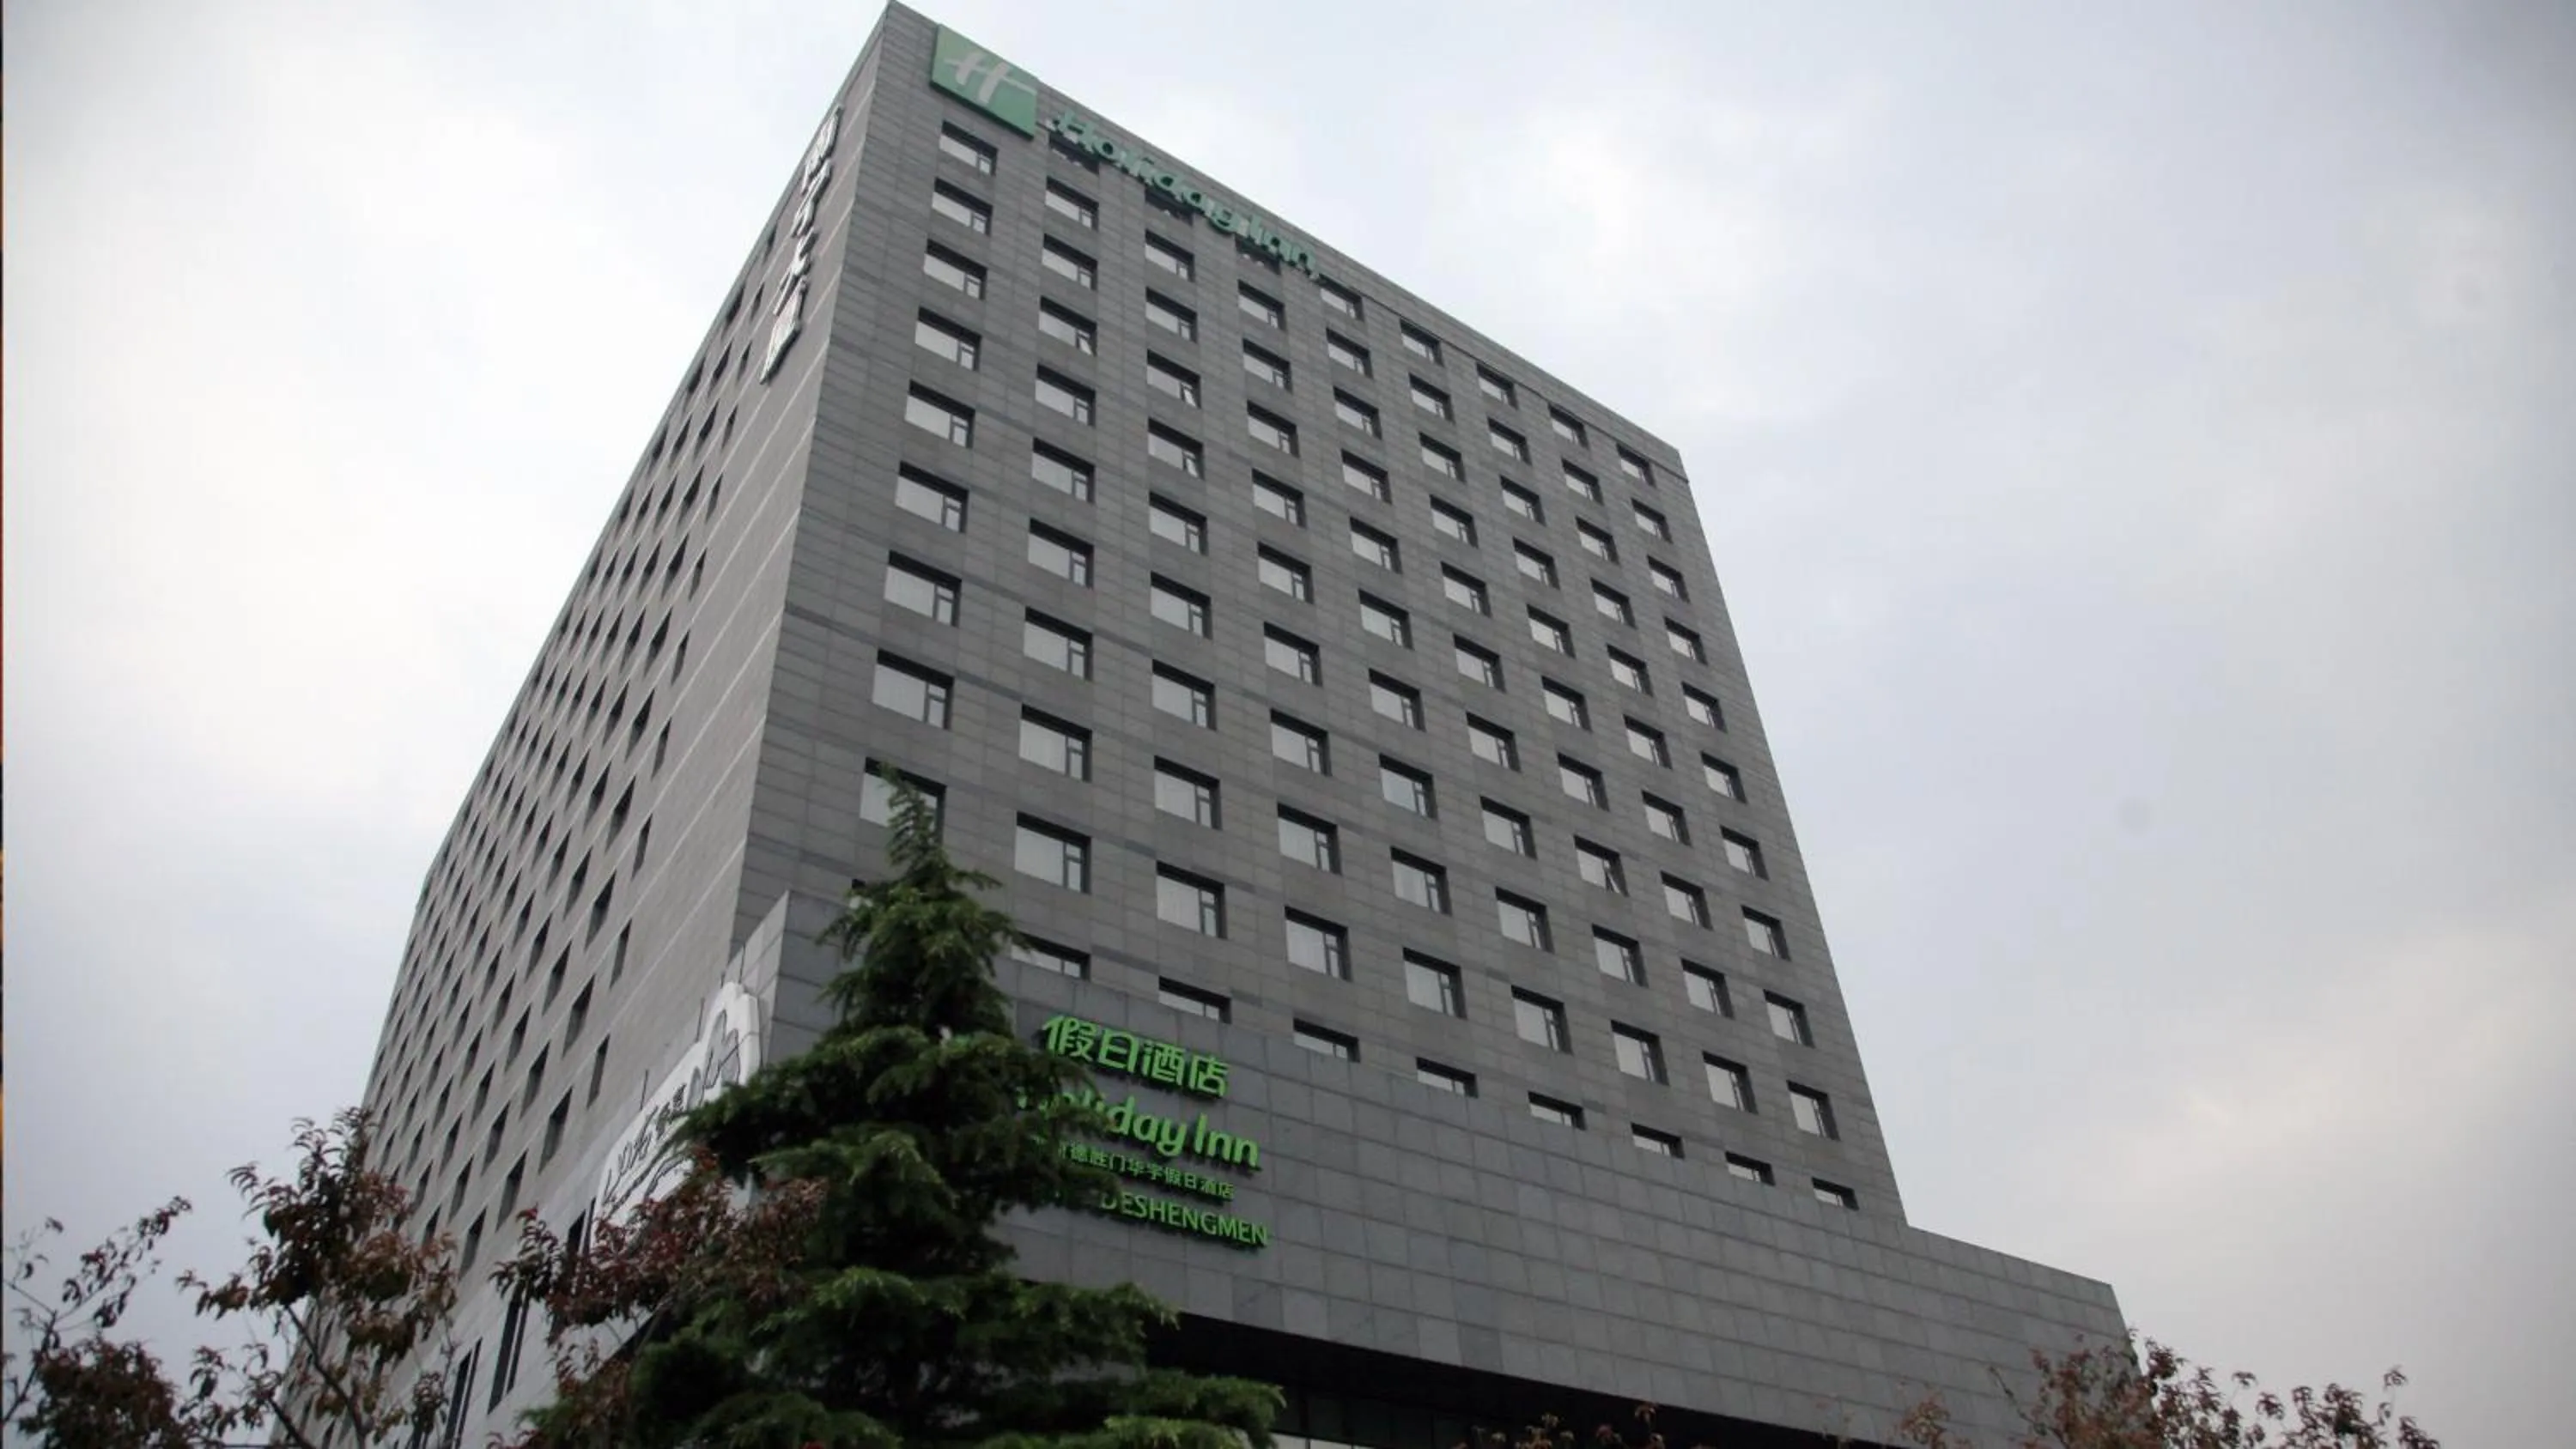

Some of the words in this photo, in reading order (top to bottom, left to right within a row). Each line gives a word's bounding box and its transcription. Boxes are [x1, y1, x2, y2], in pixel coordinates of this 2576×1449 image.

[1042, 1015, 1229, 1097] 假日酒店
[1193, 1112, 1261, 1167] Inn
[1099, 1191, 1269, 1246] DESHENGMEN
